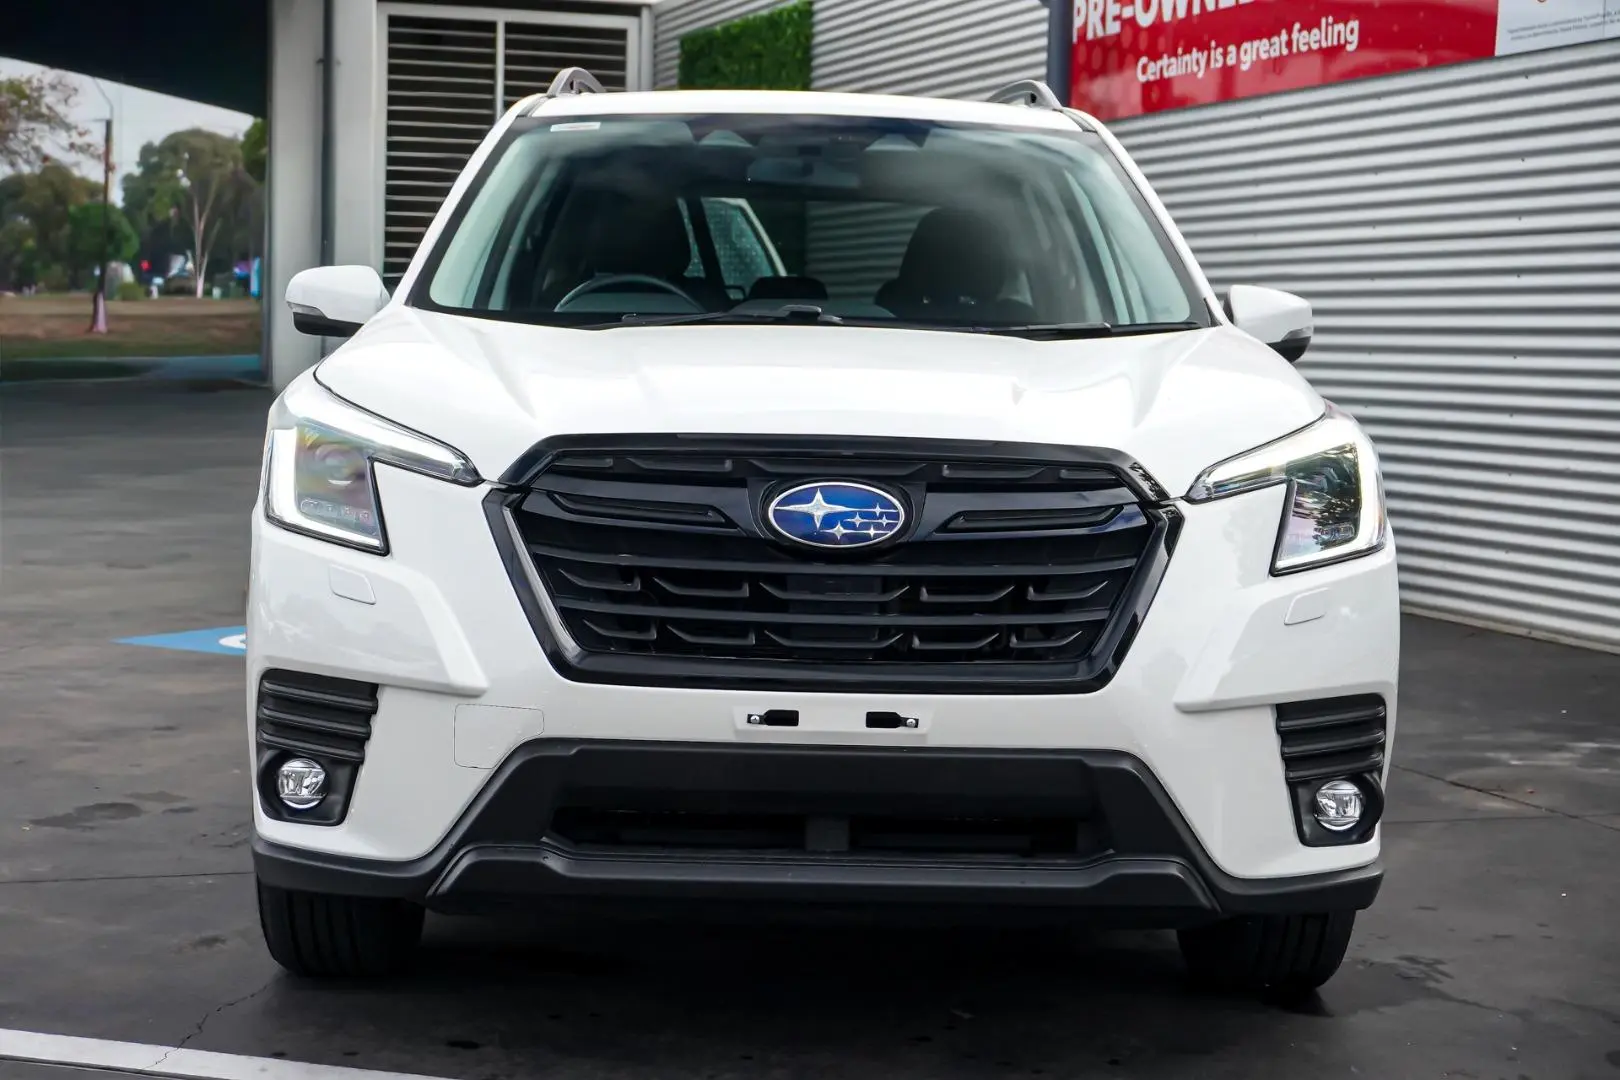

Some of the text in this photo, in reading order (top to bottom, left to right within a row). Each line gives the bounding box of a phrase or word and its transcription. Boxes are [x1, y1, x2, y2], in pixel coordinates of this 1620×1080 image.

[1072, 0, 1256, 44] PRE-O
[1136, 15, 1359, 83] Certainty is a great feeling
